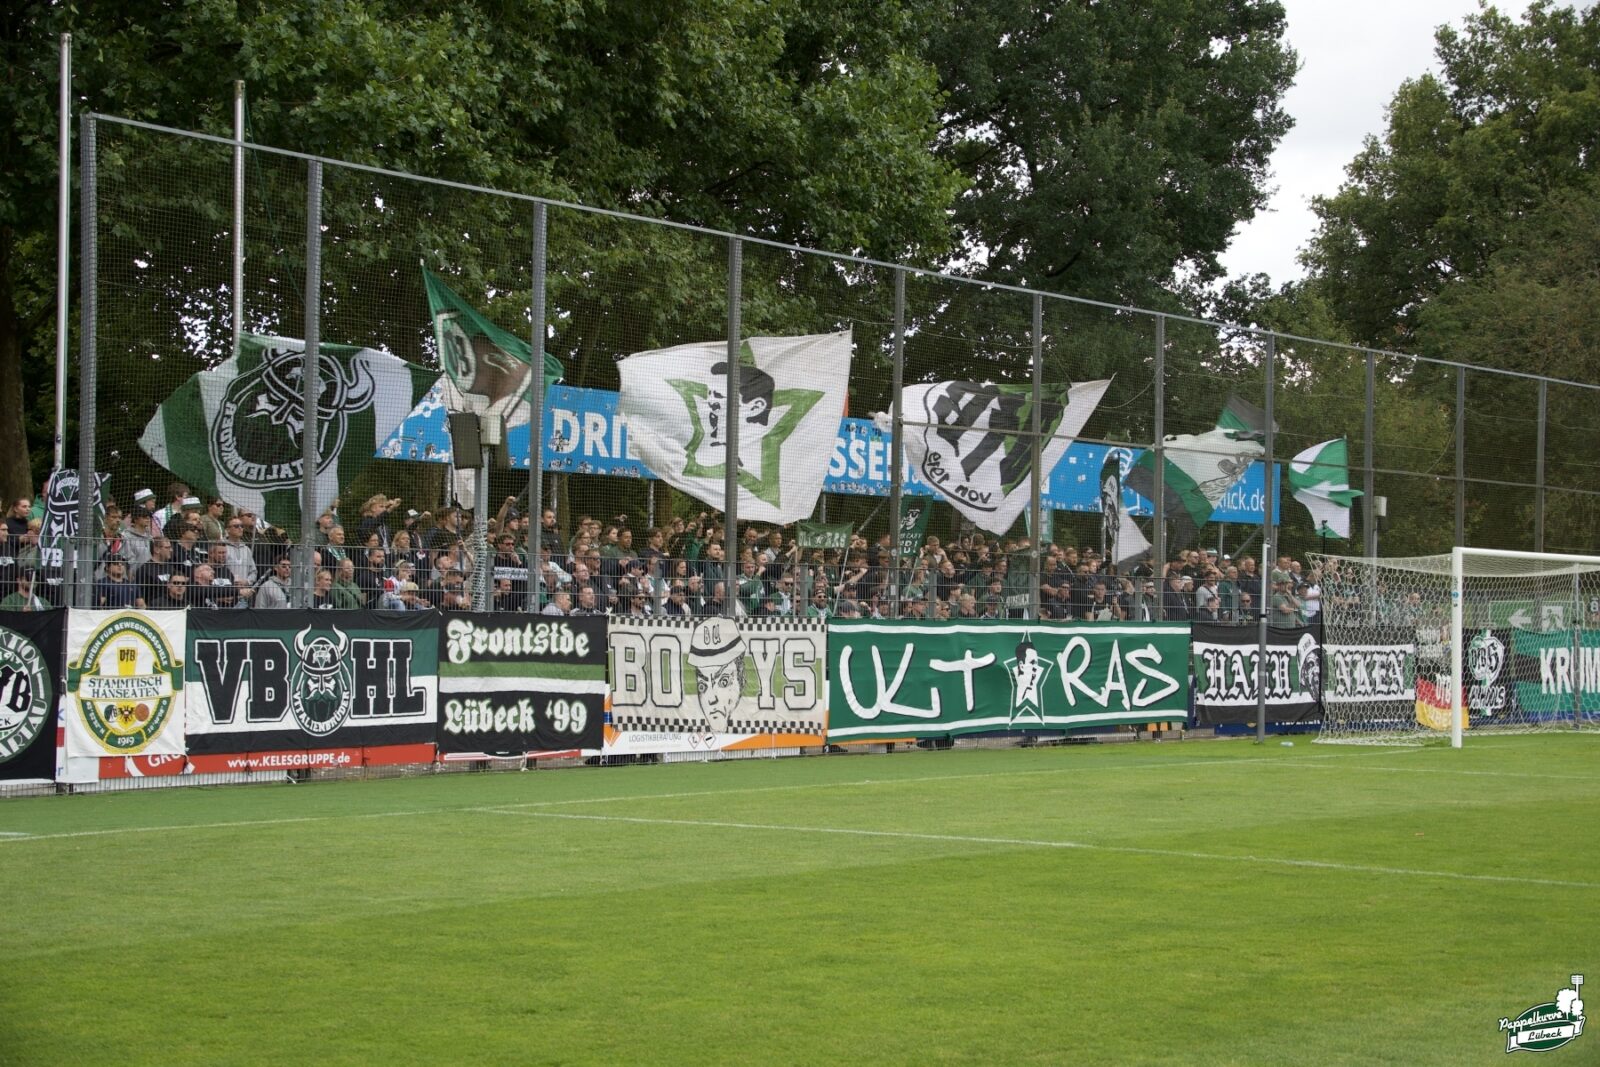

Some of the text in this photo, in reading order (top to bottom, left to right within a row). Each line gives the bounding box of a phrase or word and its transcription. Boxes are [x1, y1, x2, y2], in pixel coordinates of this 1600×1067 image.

[84, 621, 168, 669] VEREIN FÜR BEWEGUNGSSPIELE
[88, 676, 163, 689] STAMMTISCH
[91, 687, 160, 699] HANSEATEN
[444, 698, 536, 740] Lübeck
[117, 736, 135, 746] 1919
